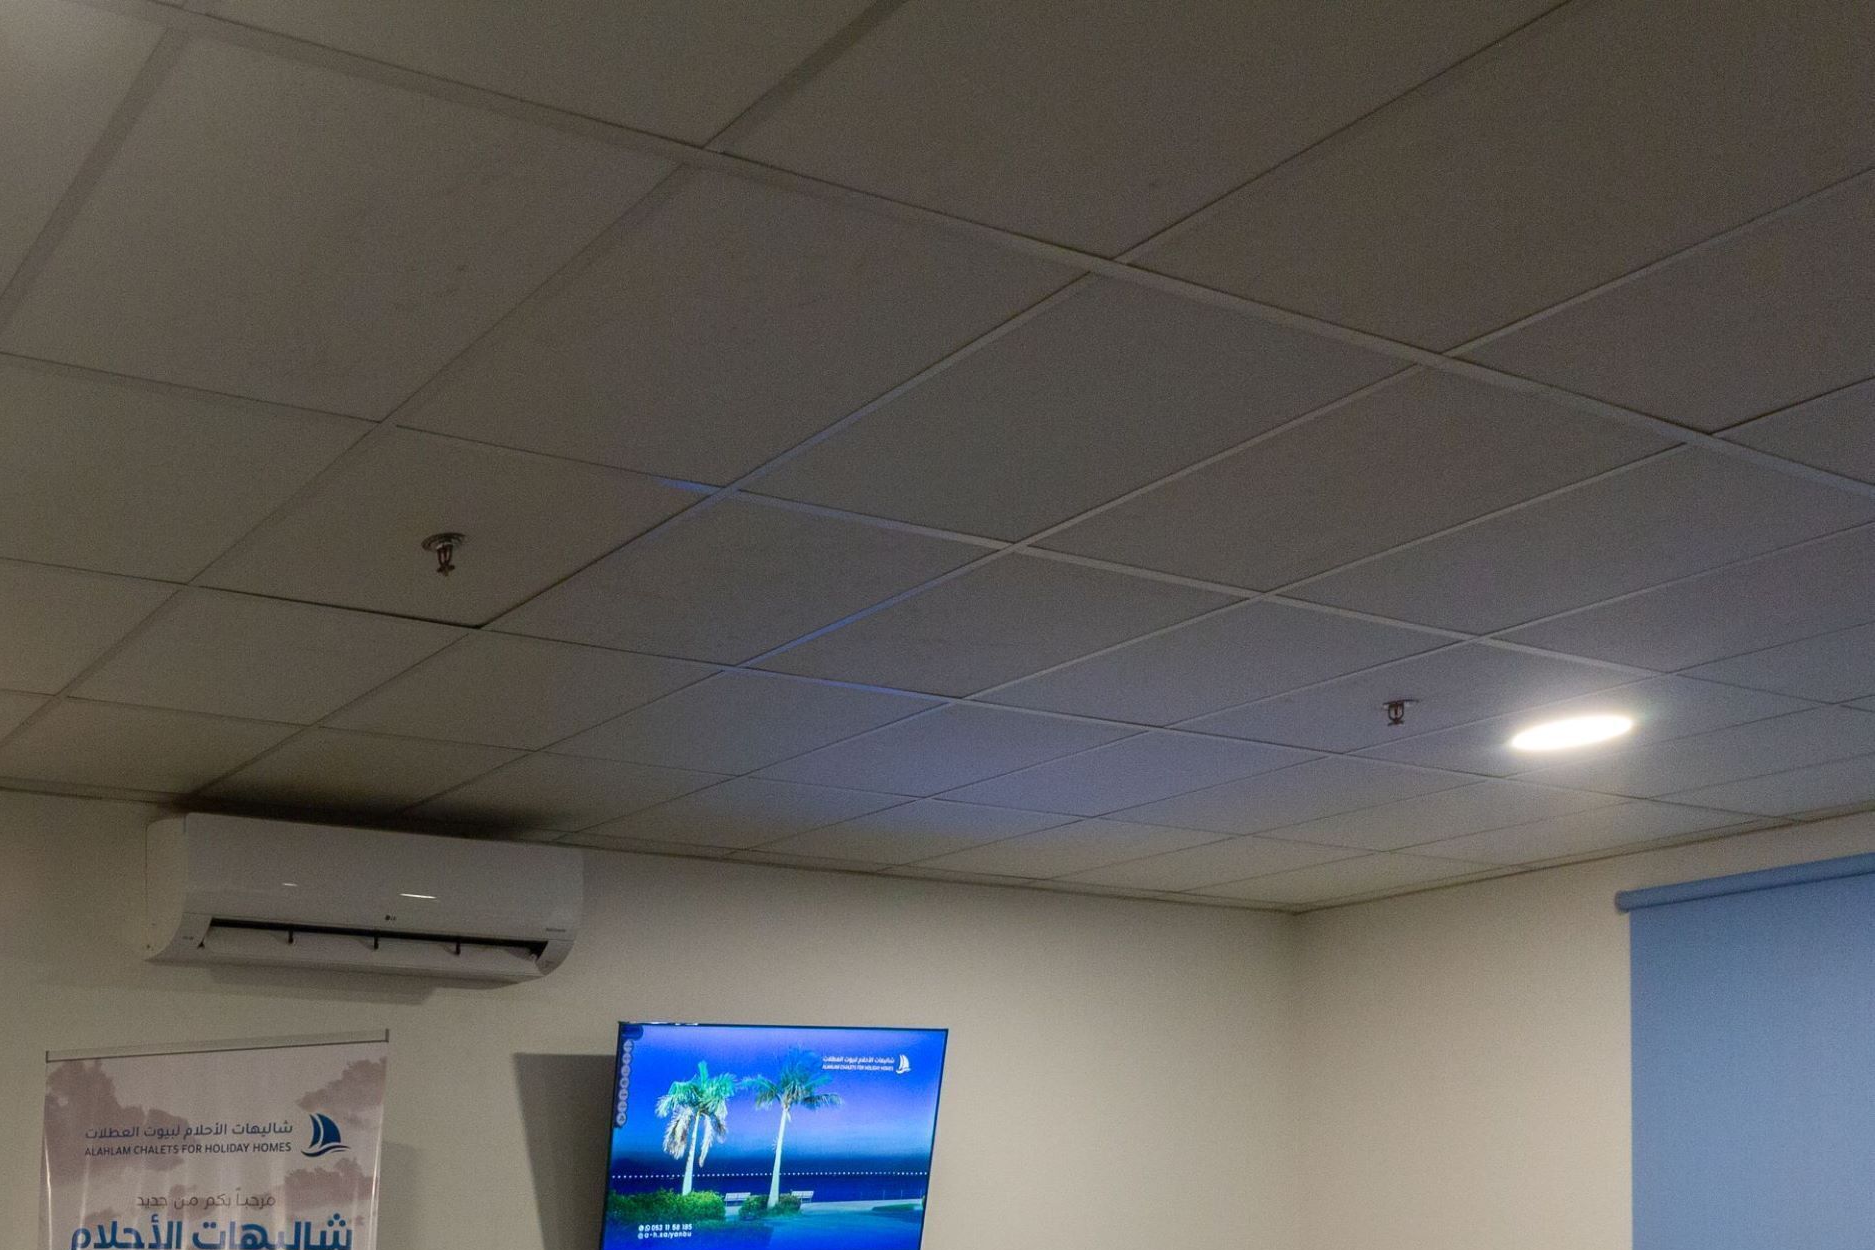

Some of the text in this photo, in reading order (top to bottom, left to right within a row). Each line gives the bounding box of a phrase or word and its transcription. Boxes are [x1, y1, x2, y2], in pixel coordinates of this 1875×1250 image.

[85, 1120, 293, 1141] شاليهات الأحلام لبيوت العطلات
[85, 1141, 292, 1156] ALAHLAM CHALETS FOR HOLIDAY HOMES
[173, 1196, 199, 1210] من
[203, 1193, 231, 1210] بكم
